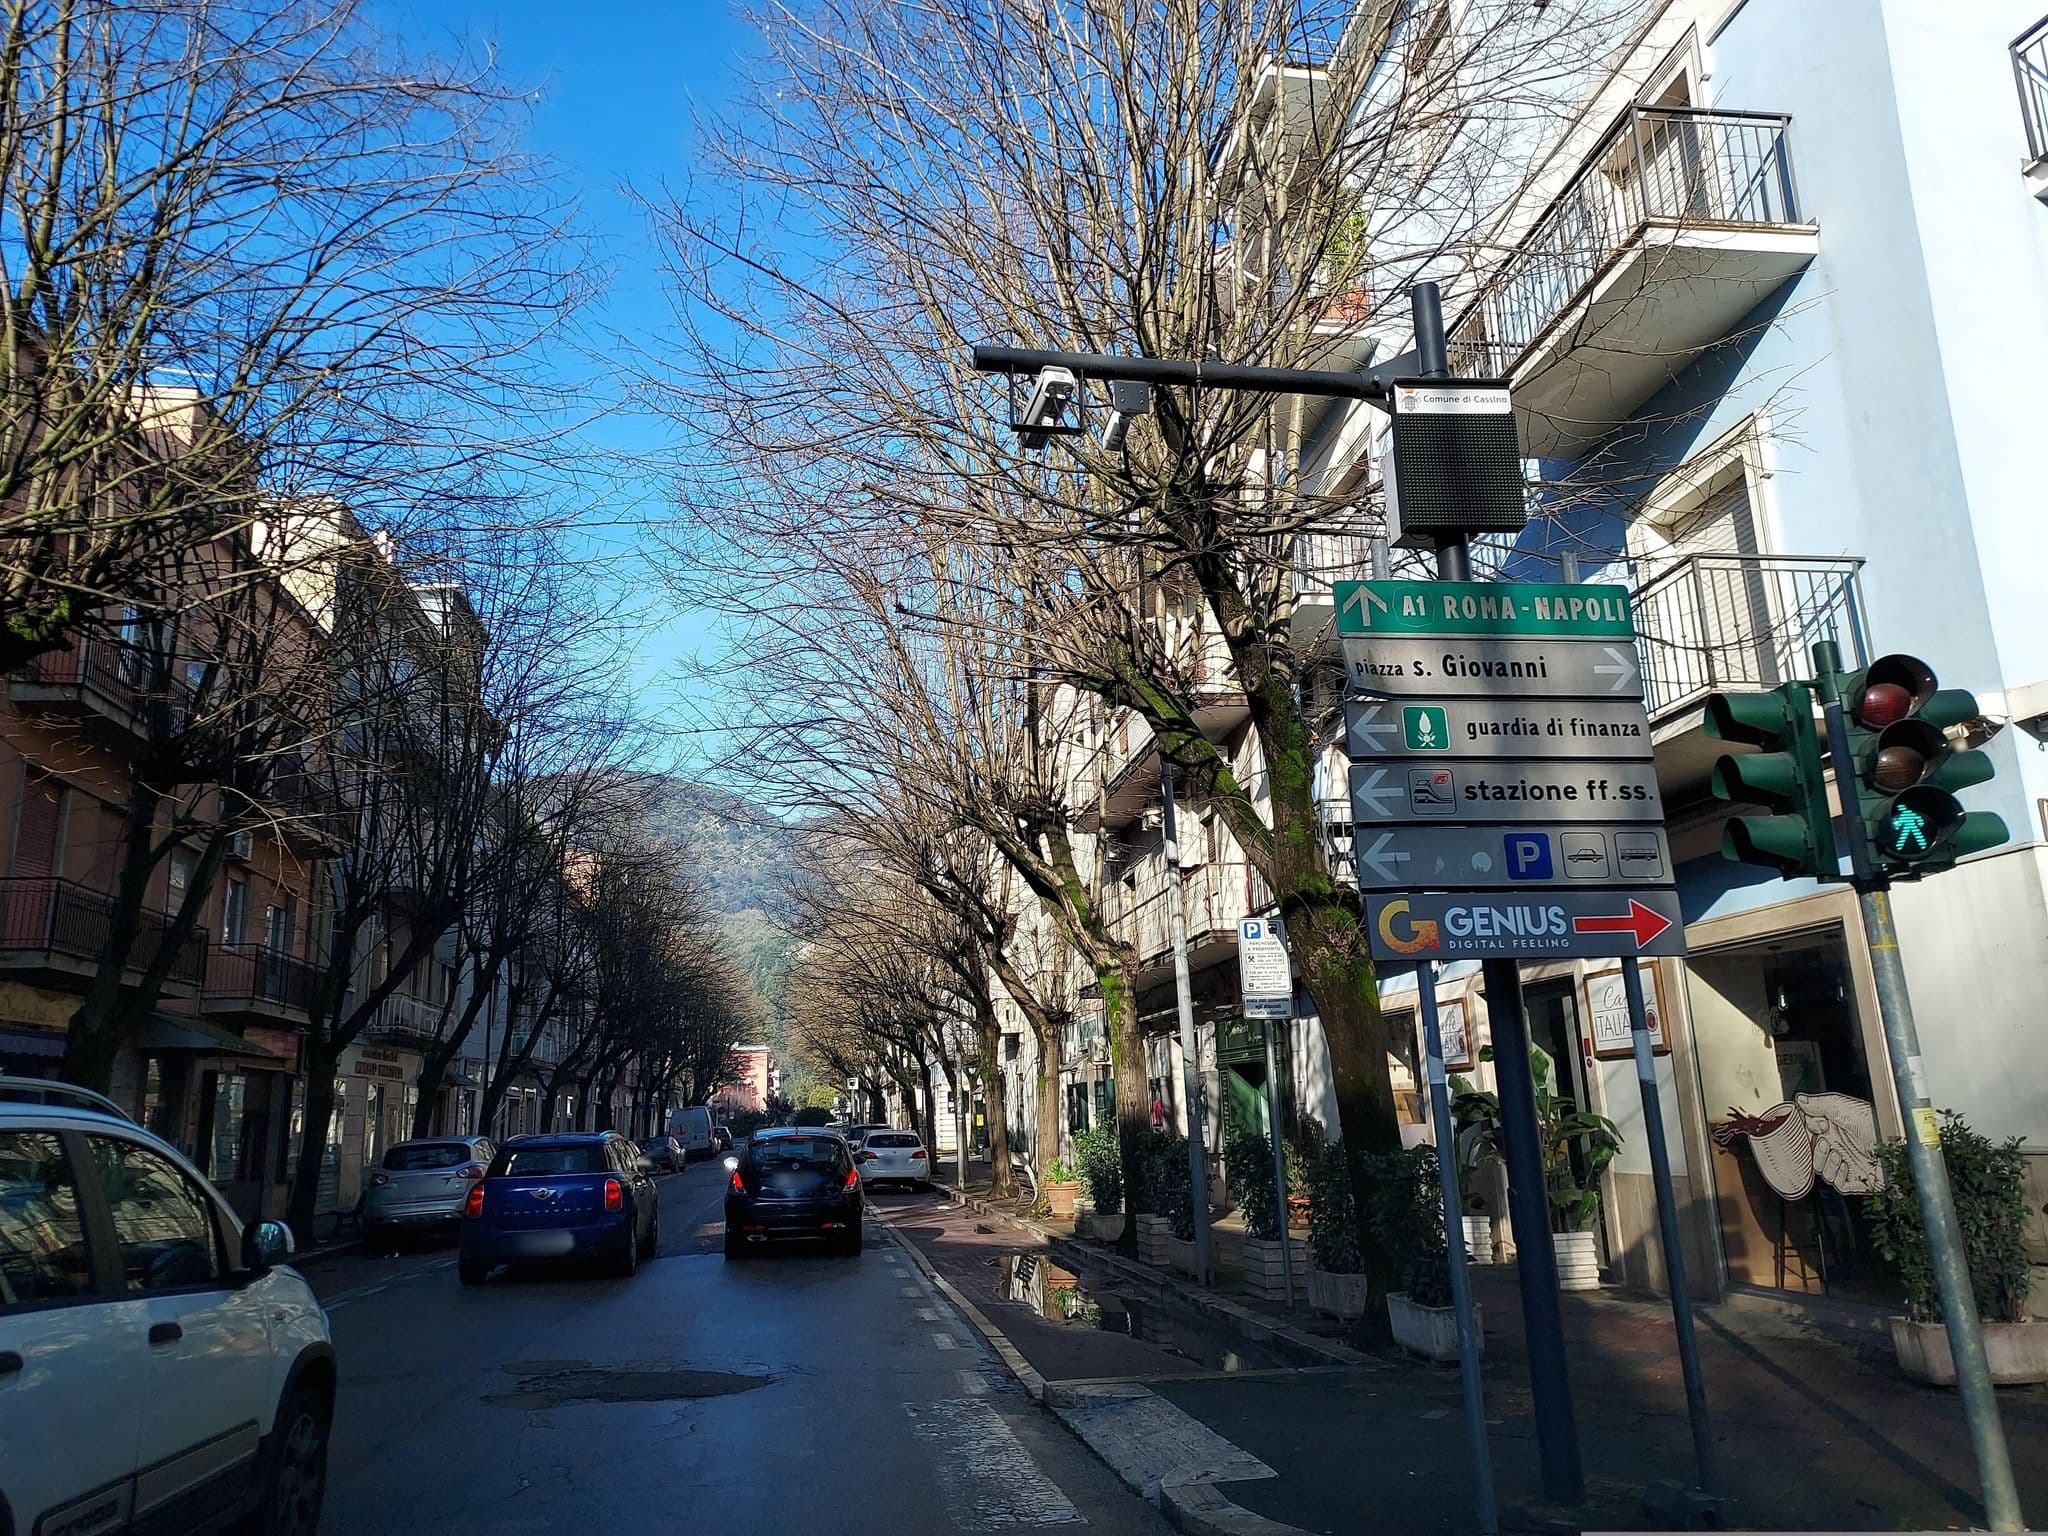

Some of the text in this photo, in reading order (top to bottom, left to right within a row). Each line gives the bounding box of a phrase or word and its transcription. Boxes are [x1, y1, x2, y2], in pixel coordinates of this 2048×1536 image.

[1423, 394, 1508, 404] Comune di Cassino
[1402, 594, 1426, 617] A1
[1355, 658, 1403, 677] piazza
[1441, 653, 1548, 679] Giovanni
[1466, 717, 1641, 741] guardia di finanza
[1464, 779, 1655, 801] stazione ff.ss.
[1516, 841, 1540, 872] P
[1246, 923, 1258, 938] P
[1444, 905, 1567, 938] GENIUS
[1449, 937, 1570, 949] DIGITAL FEELING
